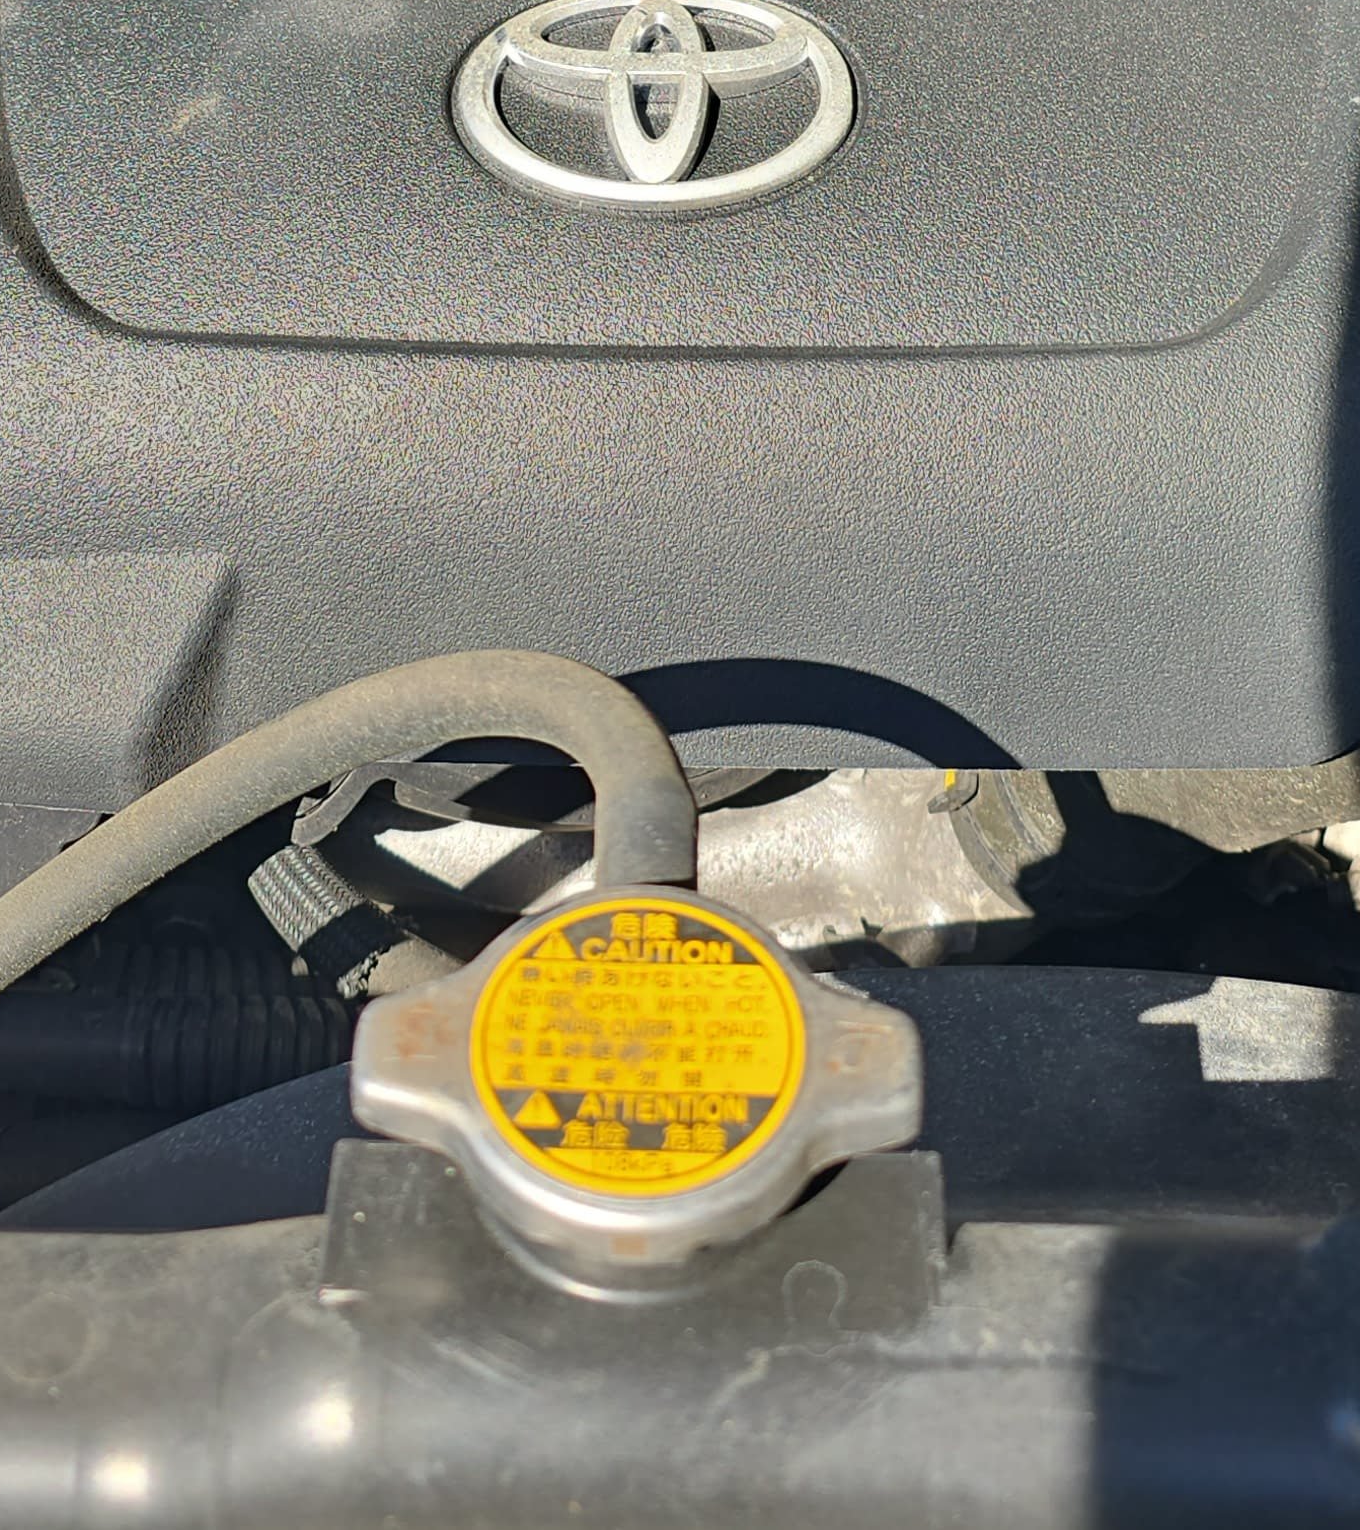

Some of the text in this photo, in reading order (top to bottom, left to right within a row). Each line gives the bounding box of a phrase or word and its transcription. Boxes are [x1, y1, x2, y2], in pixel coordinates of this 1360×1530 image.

[581, 937, 734, 963] CAUTION
[585, 992, 639, 1012] OPEN
[656, 994, 711, 1013] WHEN
[576, 1091, 749, 1123] ATTENTION
